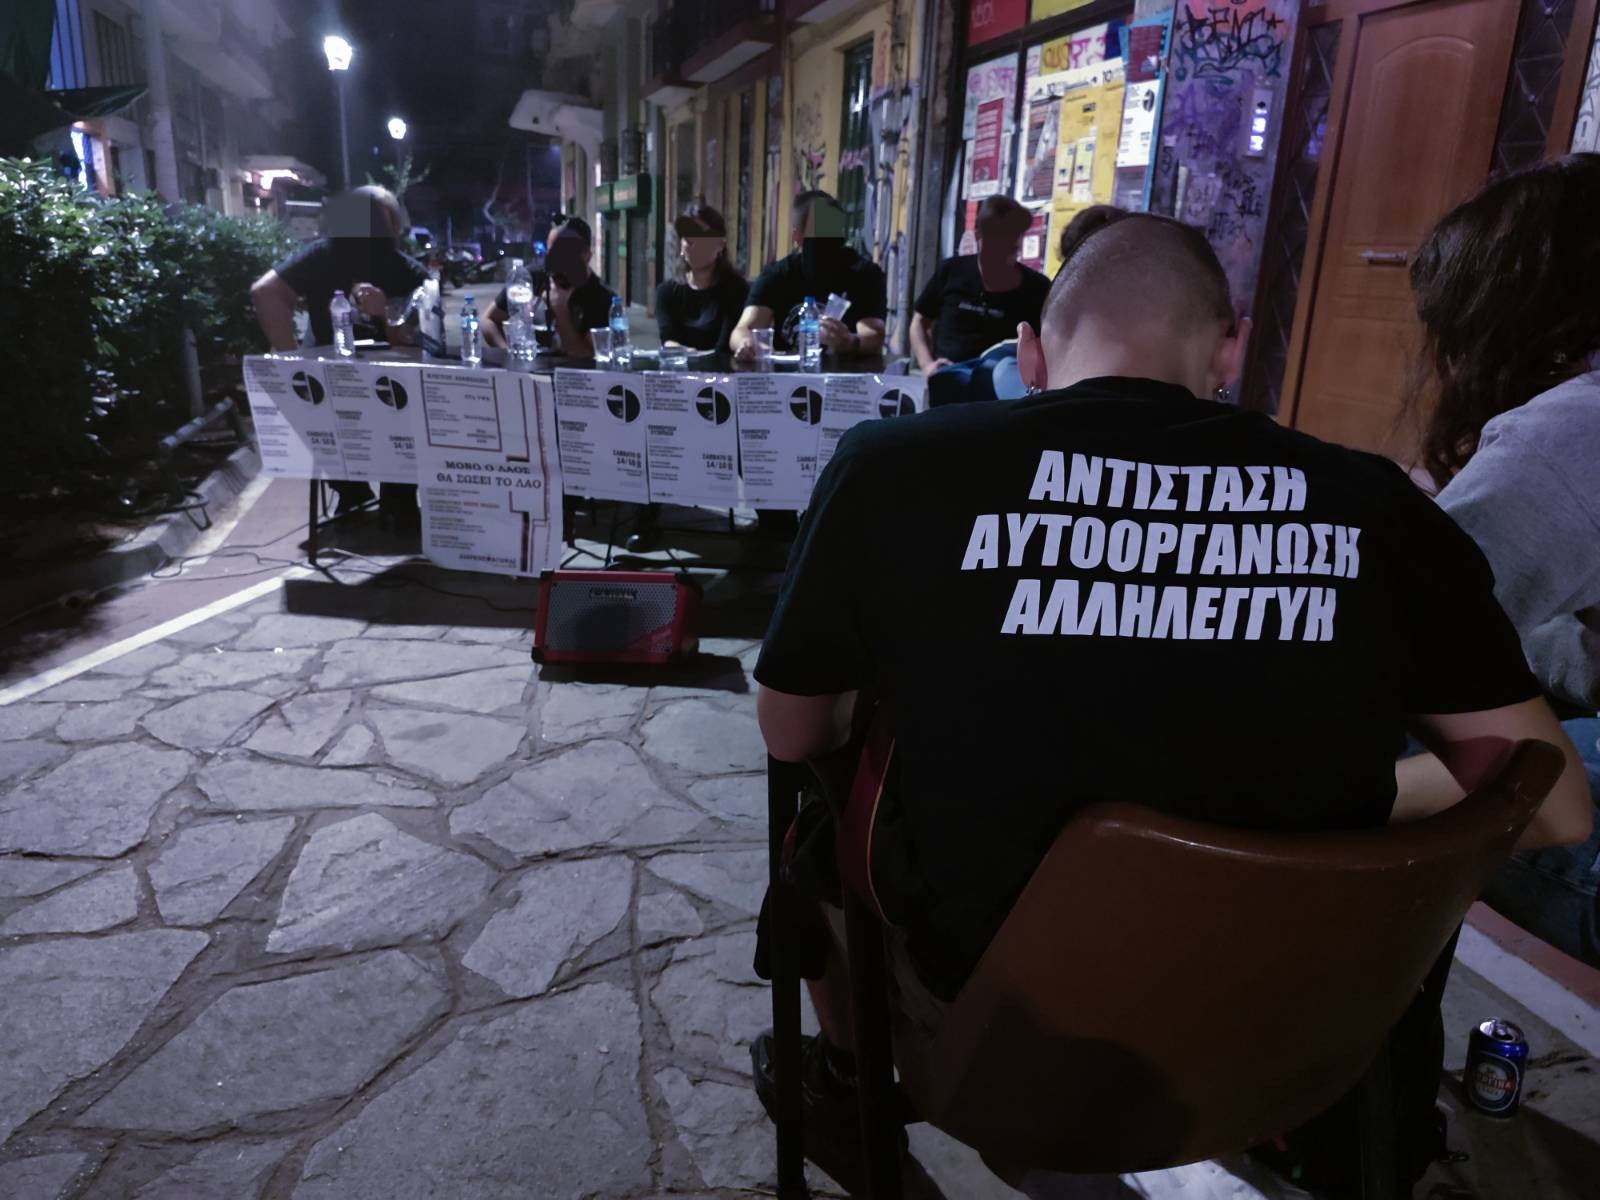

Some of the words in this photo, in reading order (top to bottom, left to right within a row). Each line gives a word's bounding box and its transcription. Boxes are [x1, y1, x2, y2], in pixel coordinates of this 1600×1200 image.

[436, 473, 453, 483] ΘΑ
[456, 474, 492, 486] ΣΩΣΕΙ
[495, 476, 513, 487] ΤΟ
[516, 478, 542, 489] ΛΑΟ
[445, 461, 482, 471] ΜΟΝΟ
[484, 463, 495, 472] Ο
[498, 465, 531, 475] ΛΑΟΣ
[1028, 450, 1307, 512] ΑΝΤΙΣΤΑΣΗ
[961, 513, 1361, 579] ΑΥΤΟΟΡΓΑΝΩΣΗ
[1000, 579, 1336, 642] ΑΛΛΗΛΕΓΓΥΗ
